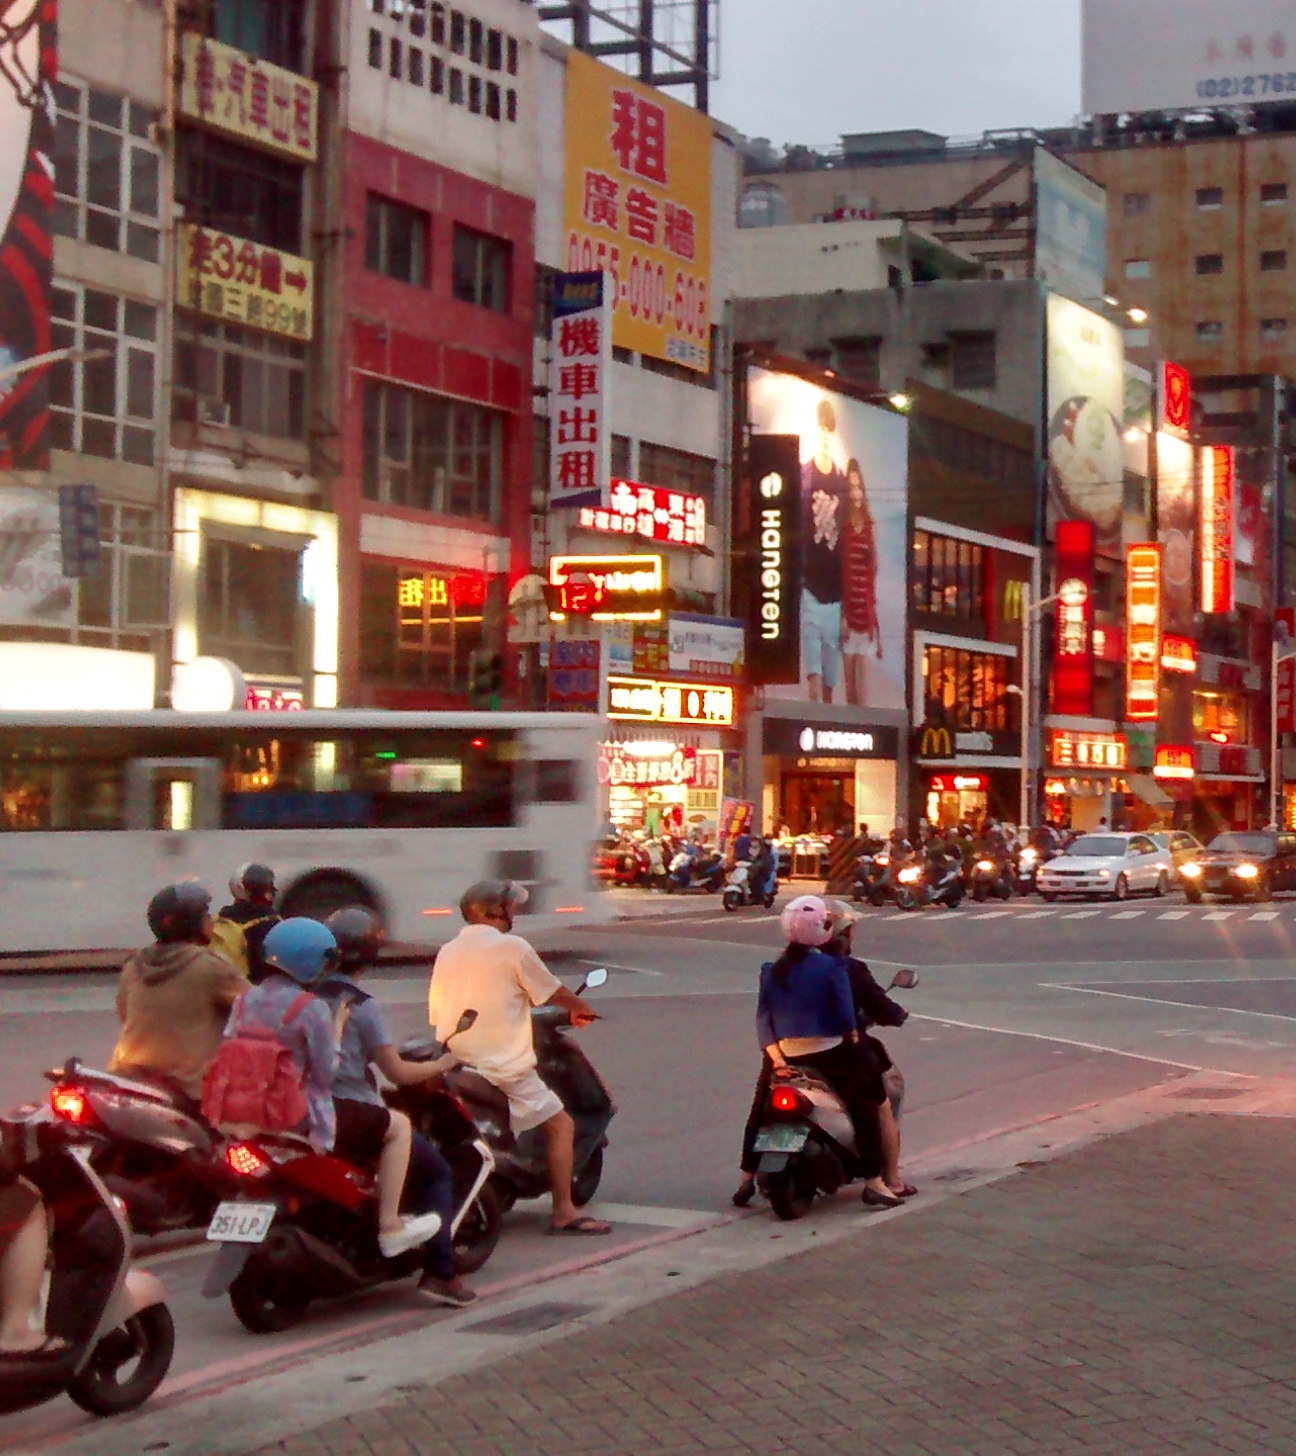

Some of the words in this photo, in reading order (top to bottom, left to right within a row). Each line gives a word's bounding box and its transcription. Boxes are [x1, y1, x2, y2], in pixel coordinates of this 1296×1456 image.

[610, 88, 667, 185] 租
[557, 318, 601, 489] 機車出租
